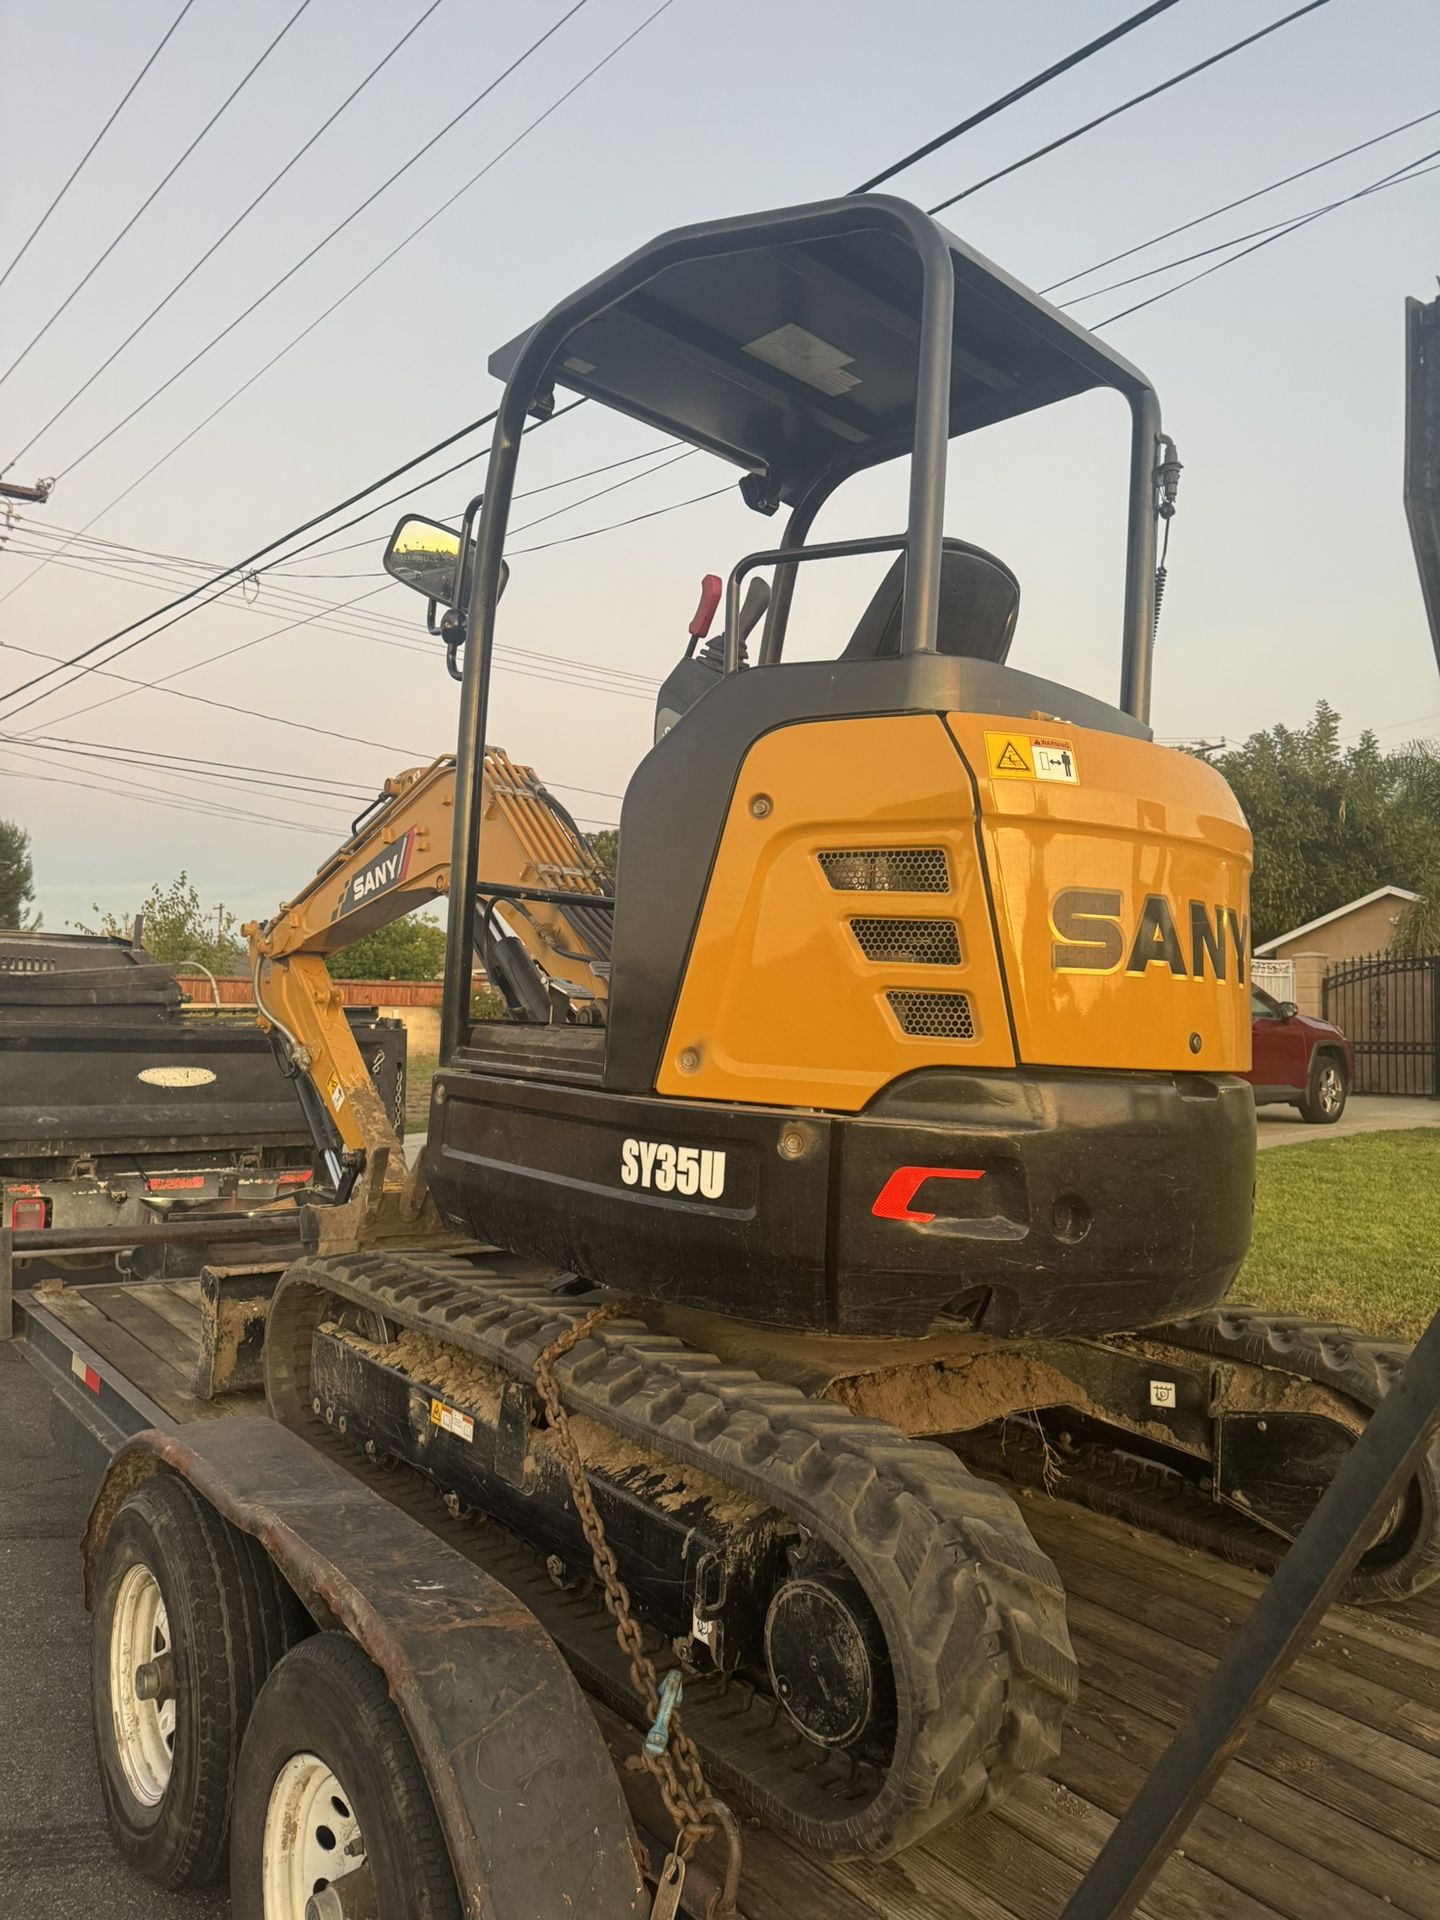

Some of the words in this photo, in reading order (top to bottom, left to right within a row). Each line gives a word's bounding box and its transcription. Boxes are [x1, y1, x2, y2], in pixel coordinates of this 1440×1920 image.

[353, 854, 398, 901] SANY
[1049, 887, 1248, 988] SANY
[621, 1138, 726, 1199] SY35U
